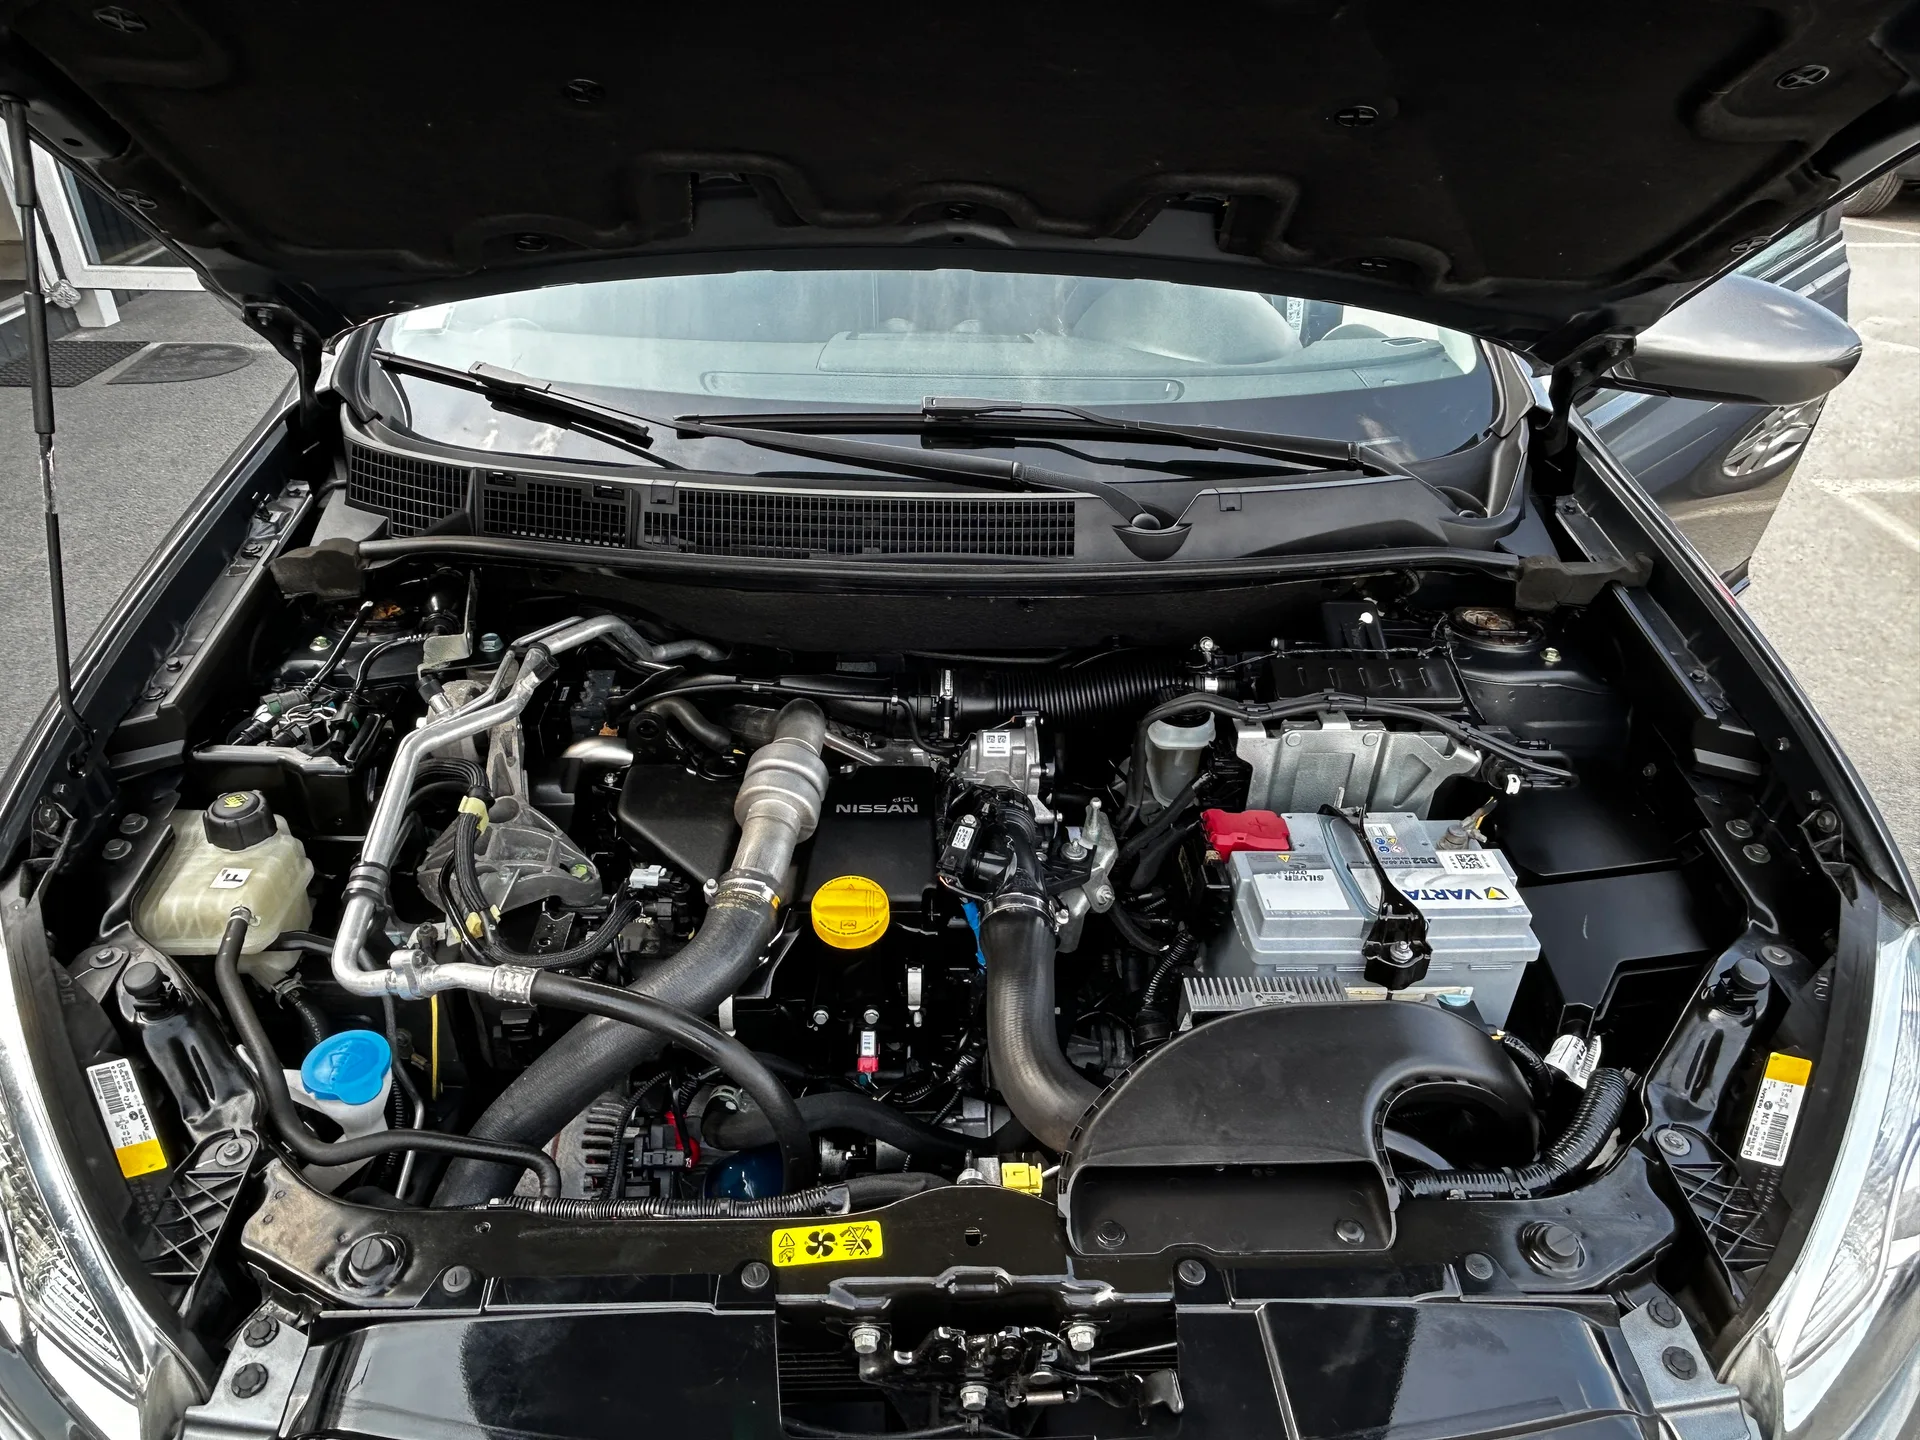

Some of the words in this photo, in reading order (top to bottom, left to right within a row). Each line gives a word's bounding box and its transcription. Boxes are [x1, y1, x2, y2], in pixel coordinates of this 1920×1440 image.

[835, 804, 919, 813] NISSAN
[222, 873, 244, 883] F
[1284, 874, 1325, 882] SILVER
[1402, 888, 1483, 901] VARTA
[1757, 1087, 1768, 1109] NISSAN
